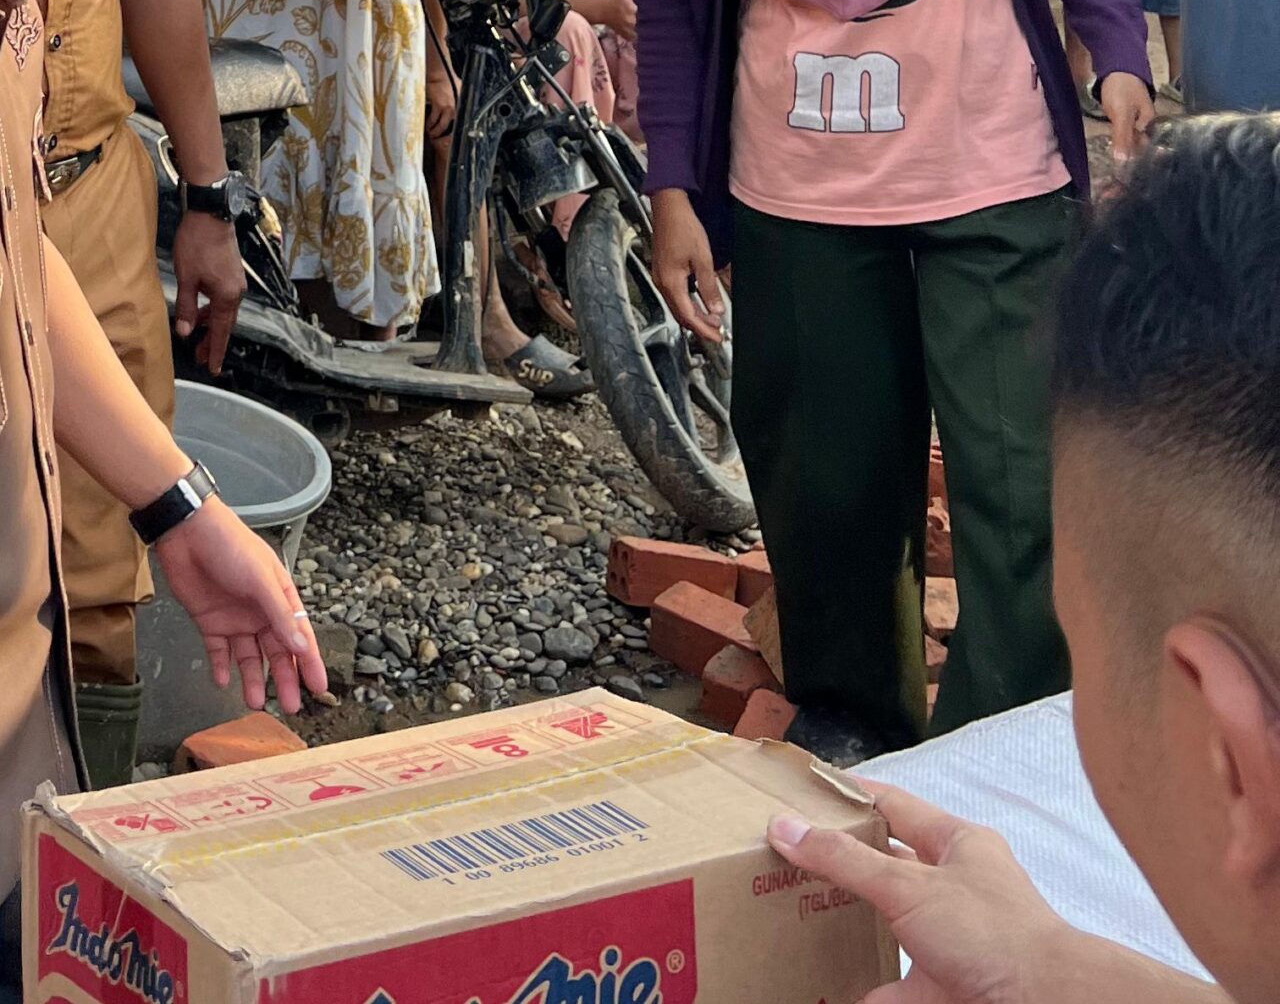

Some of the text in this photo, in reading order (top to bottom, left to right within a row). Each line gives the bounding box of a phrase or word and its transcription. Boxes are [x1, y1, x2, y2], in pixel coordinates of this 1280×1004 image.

[464, 868, 492, 882] 00
[498, 853, 560, 874] 89686
[566, 837, 625, 858] 01001
[630, 832, 649, 843] 2
